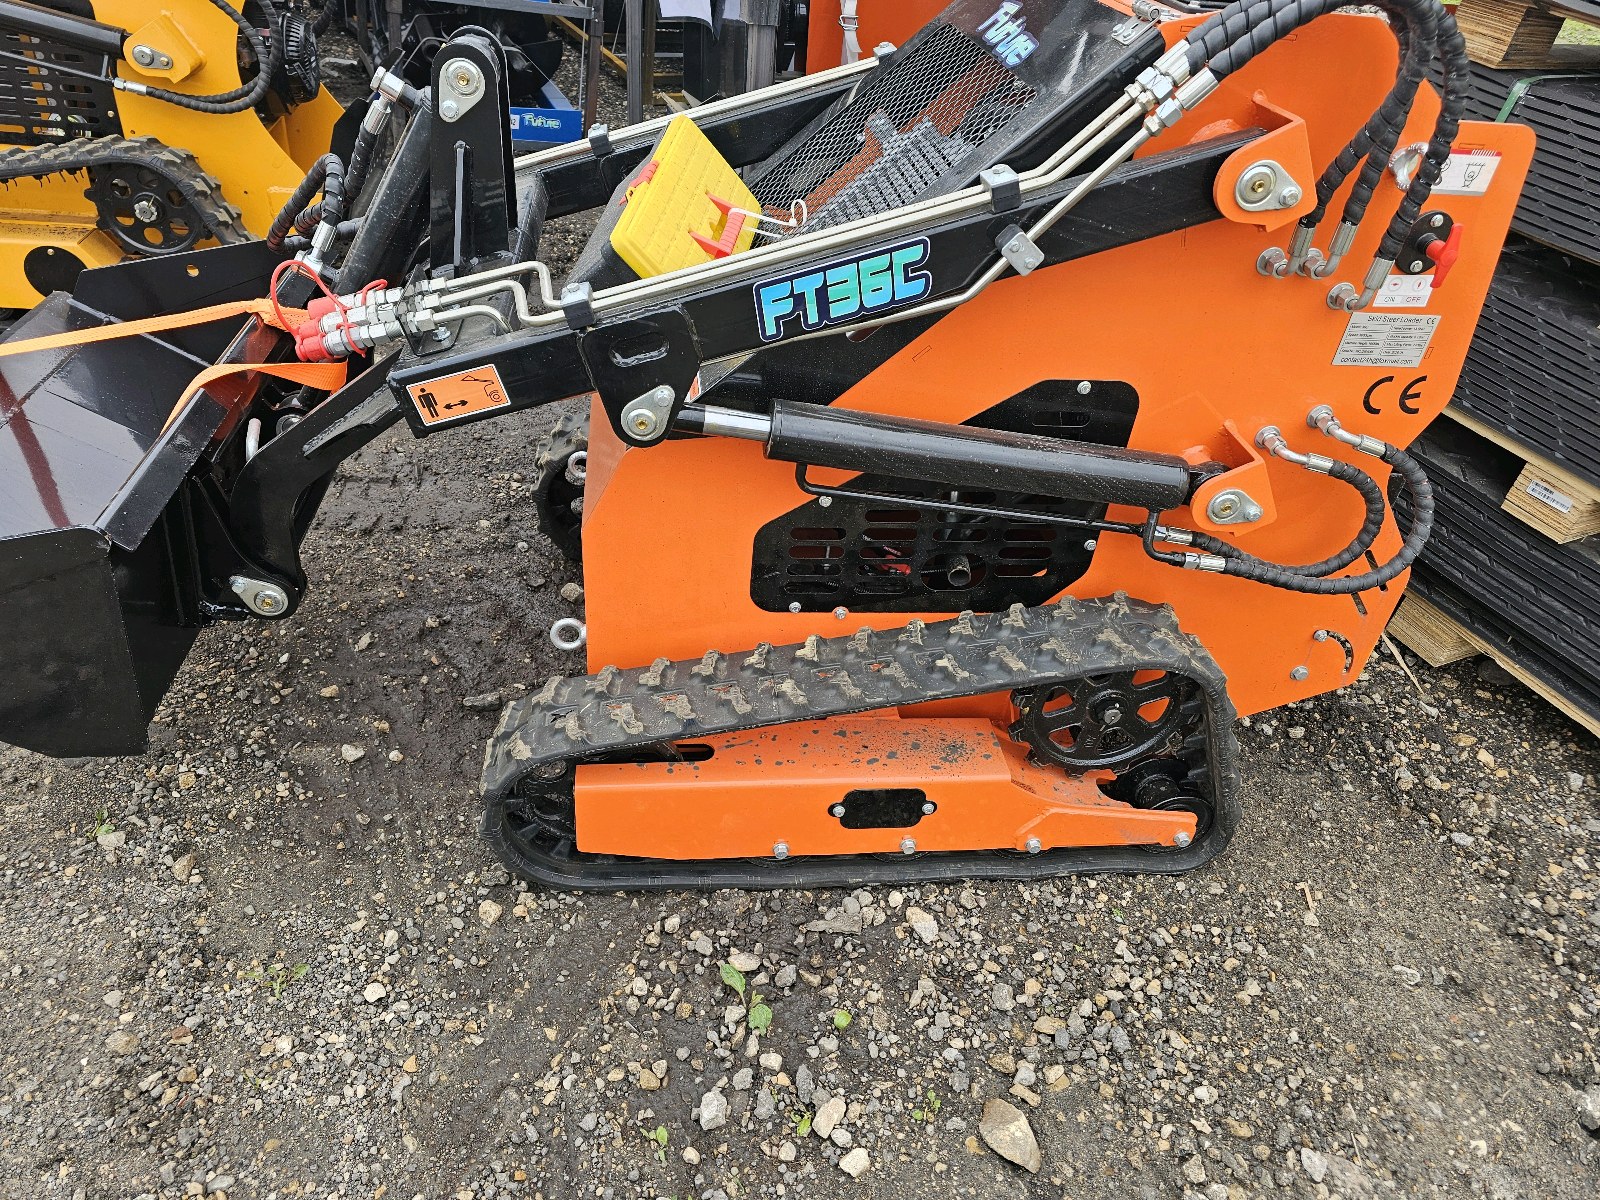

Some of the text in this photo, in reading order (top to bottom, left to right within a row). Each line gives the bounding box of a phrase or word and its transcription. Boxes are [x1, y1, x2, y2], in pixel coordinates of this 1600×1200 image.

[977, 0, 1038, 66] Future
[521, 113, 561, 129] Future
[757, 240, 929, 339] FT36C
[1362, 374, 1428, 414] CE
